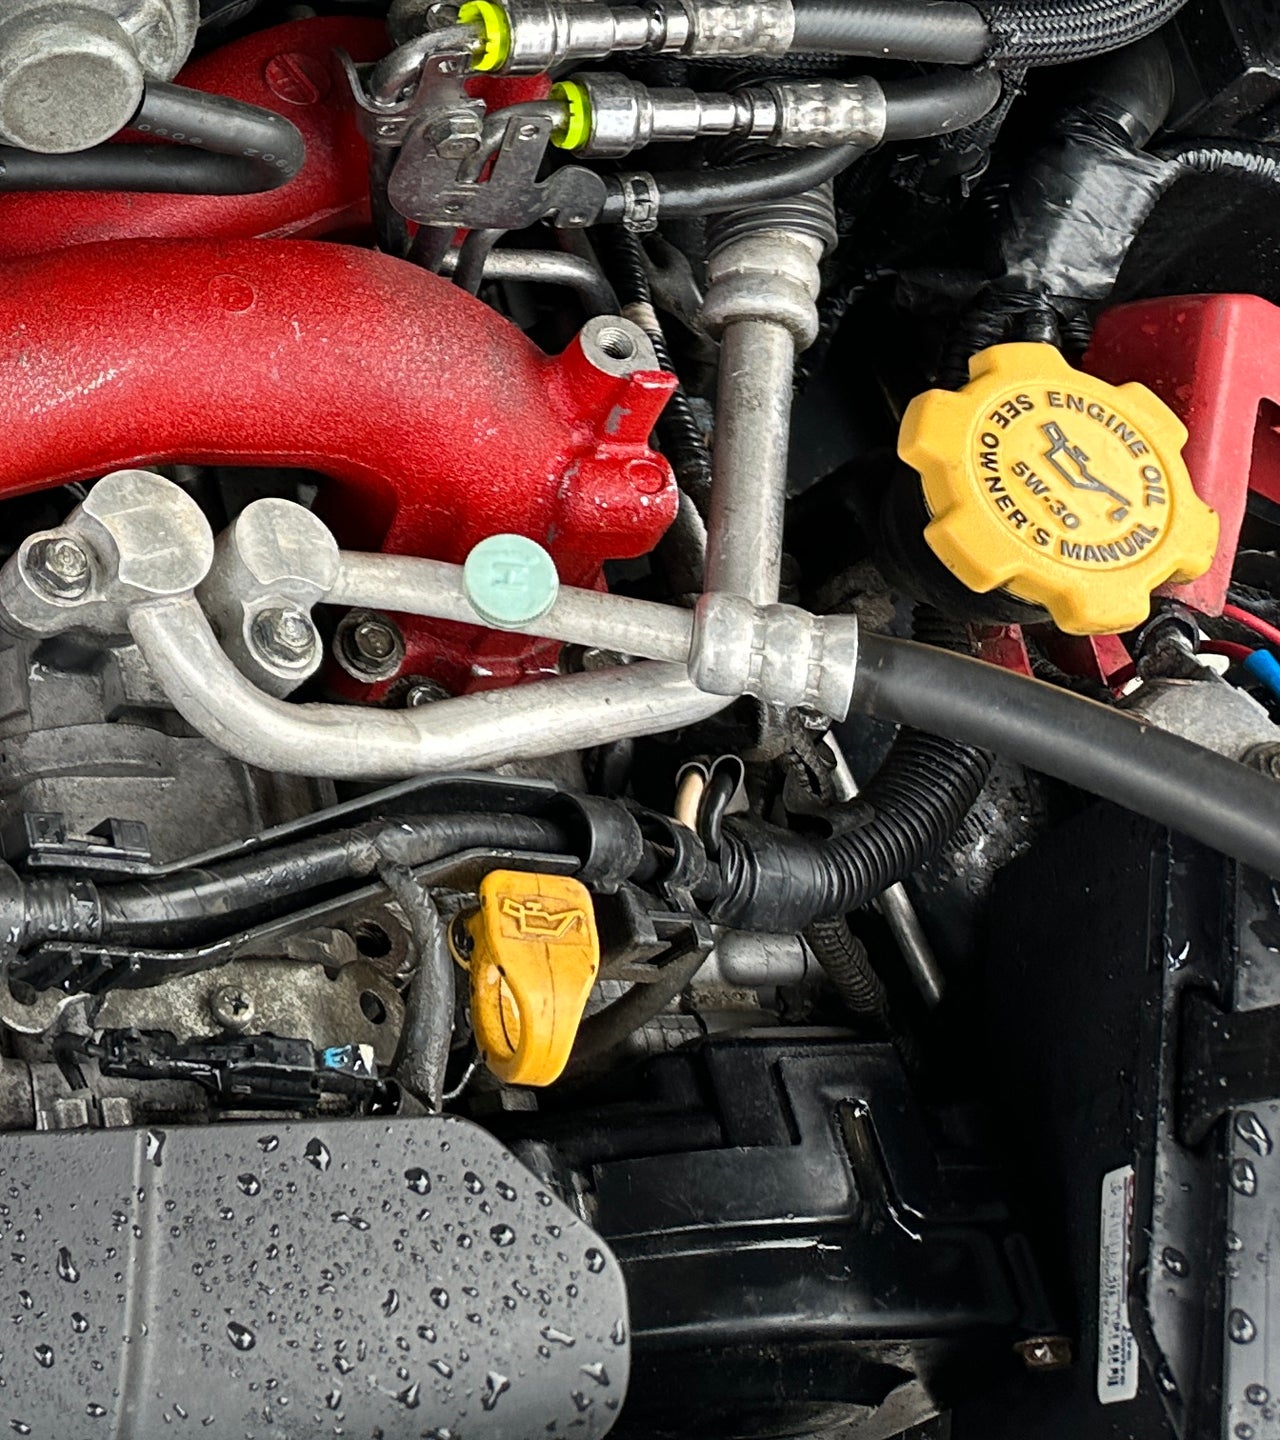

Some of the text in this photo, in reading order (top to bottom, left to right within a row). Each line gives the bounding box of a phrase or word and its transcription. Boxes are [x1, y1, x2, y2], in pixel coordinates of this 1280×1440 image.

[979, 394, 1159, 563] SEE OWNER'S MANUAL
[1011, 460, 1081, 531] 5W-30
[1046, 390, 1166, 508] ENGINE OIL
